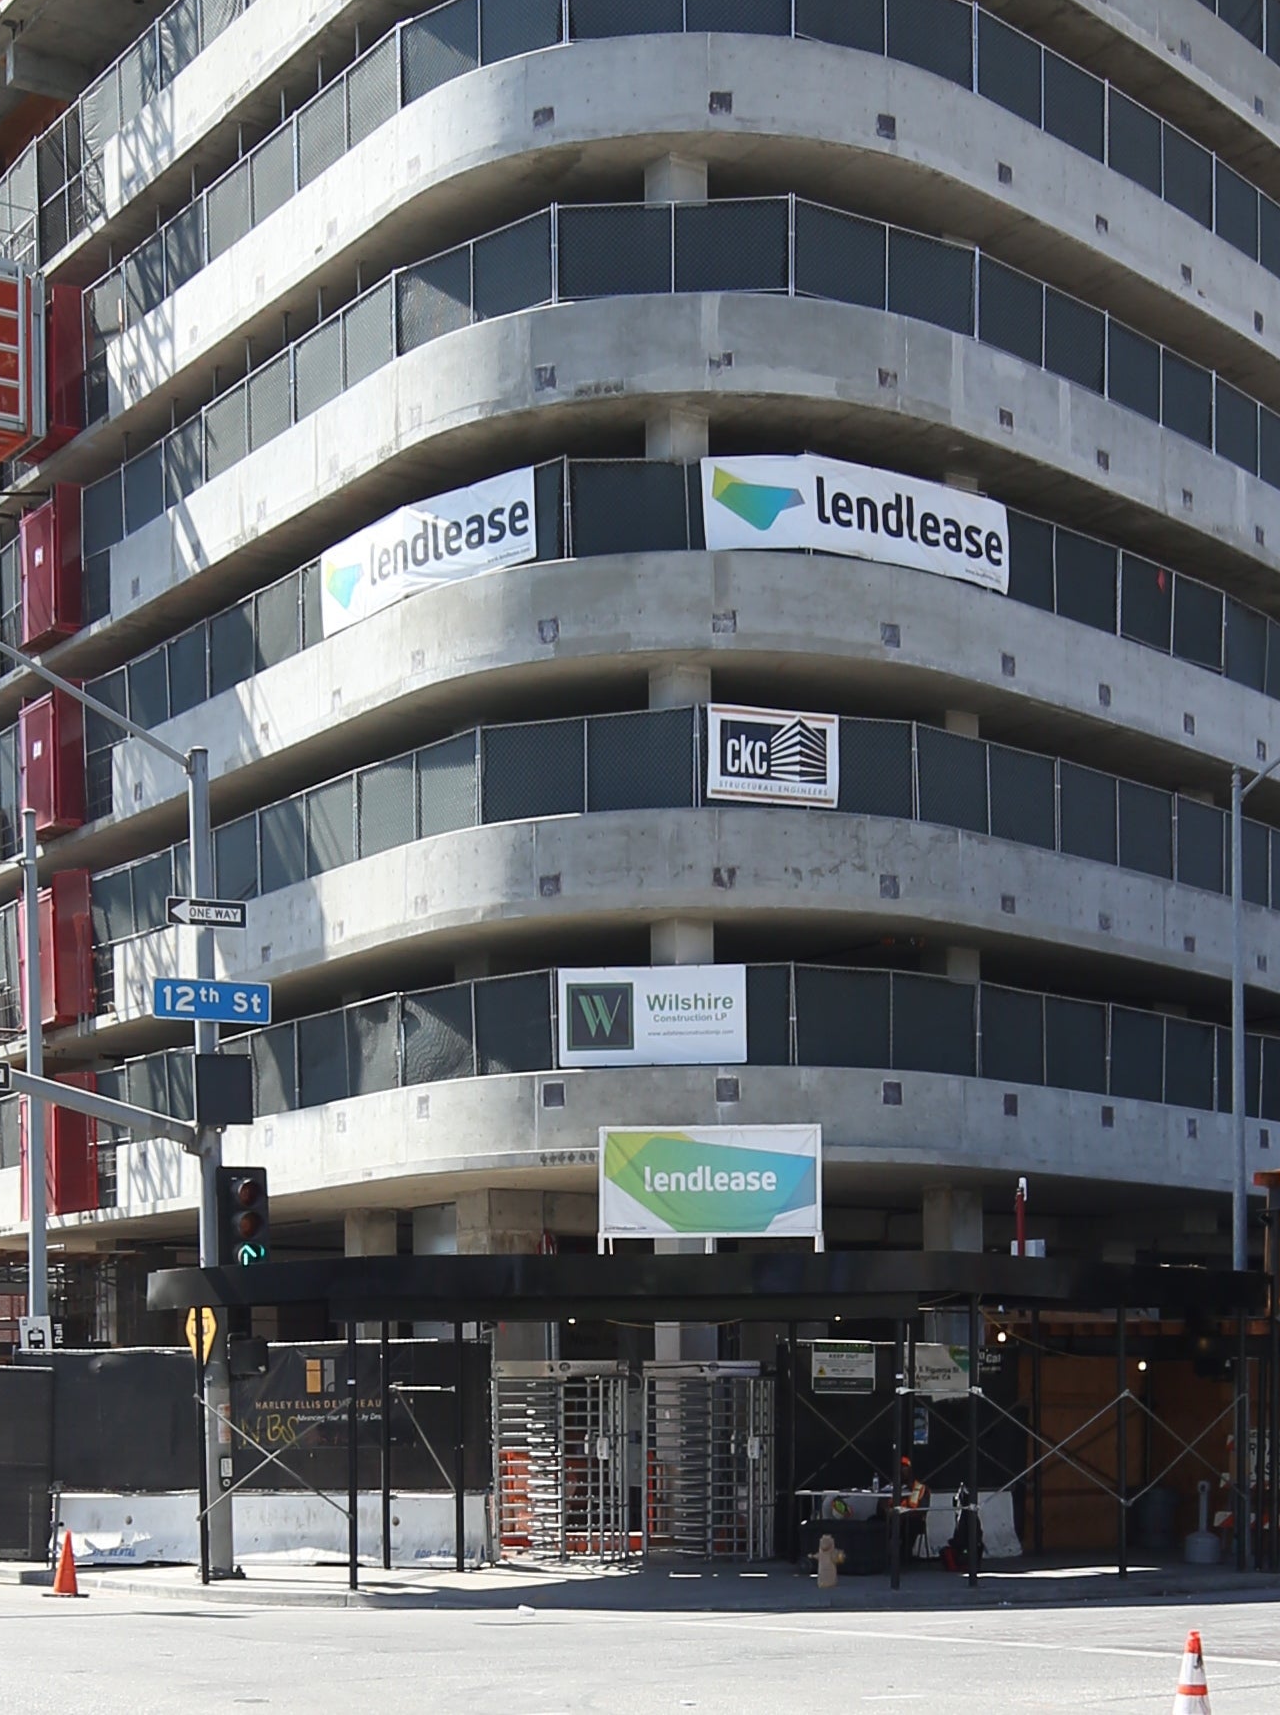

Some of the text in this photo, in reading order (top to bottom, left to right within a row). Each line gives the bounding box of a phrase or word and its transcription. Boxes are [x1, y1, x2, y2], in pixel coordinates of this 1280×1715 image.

[816, 475, 1004, 567] lendlease
[370, 500, 530, 586] lendlease
[719, 780, 828, 796] STRUCTURAL ENGINEERS
[189, 907, 239, 920] ONE WAY
[163, 985, 262, 1014] 12th St
[646, 992, 734, 1012] Wilshire
[653, 1012, 728, 1023] Construction LP
[643, 1165, 778, 1193] lendlease
[54, 1323, 64, 1344] Rail
[255, 1400, 292, 1410] HARLEY
[294, 1399, 321, 1409] ELLIS
